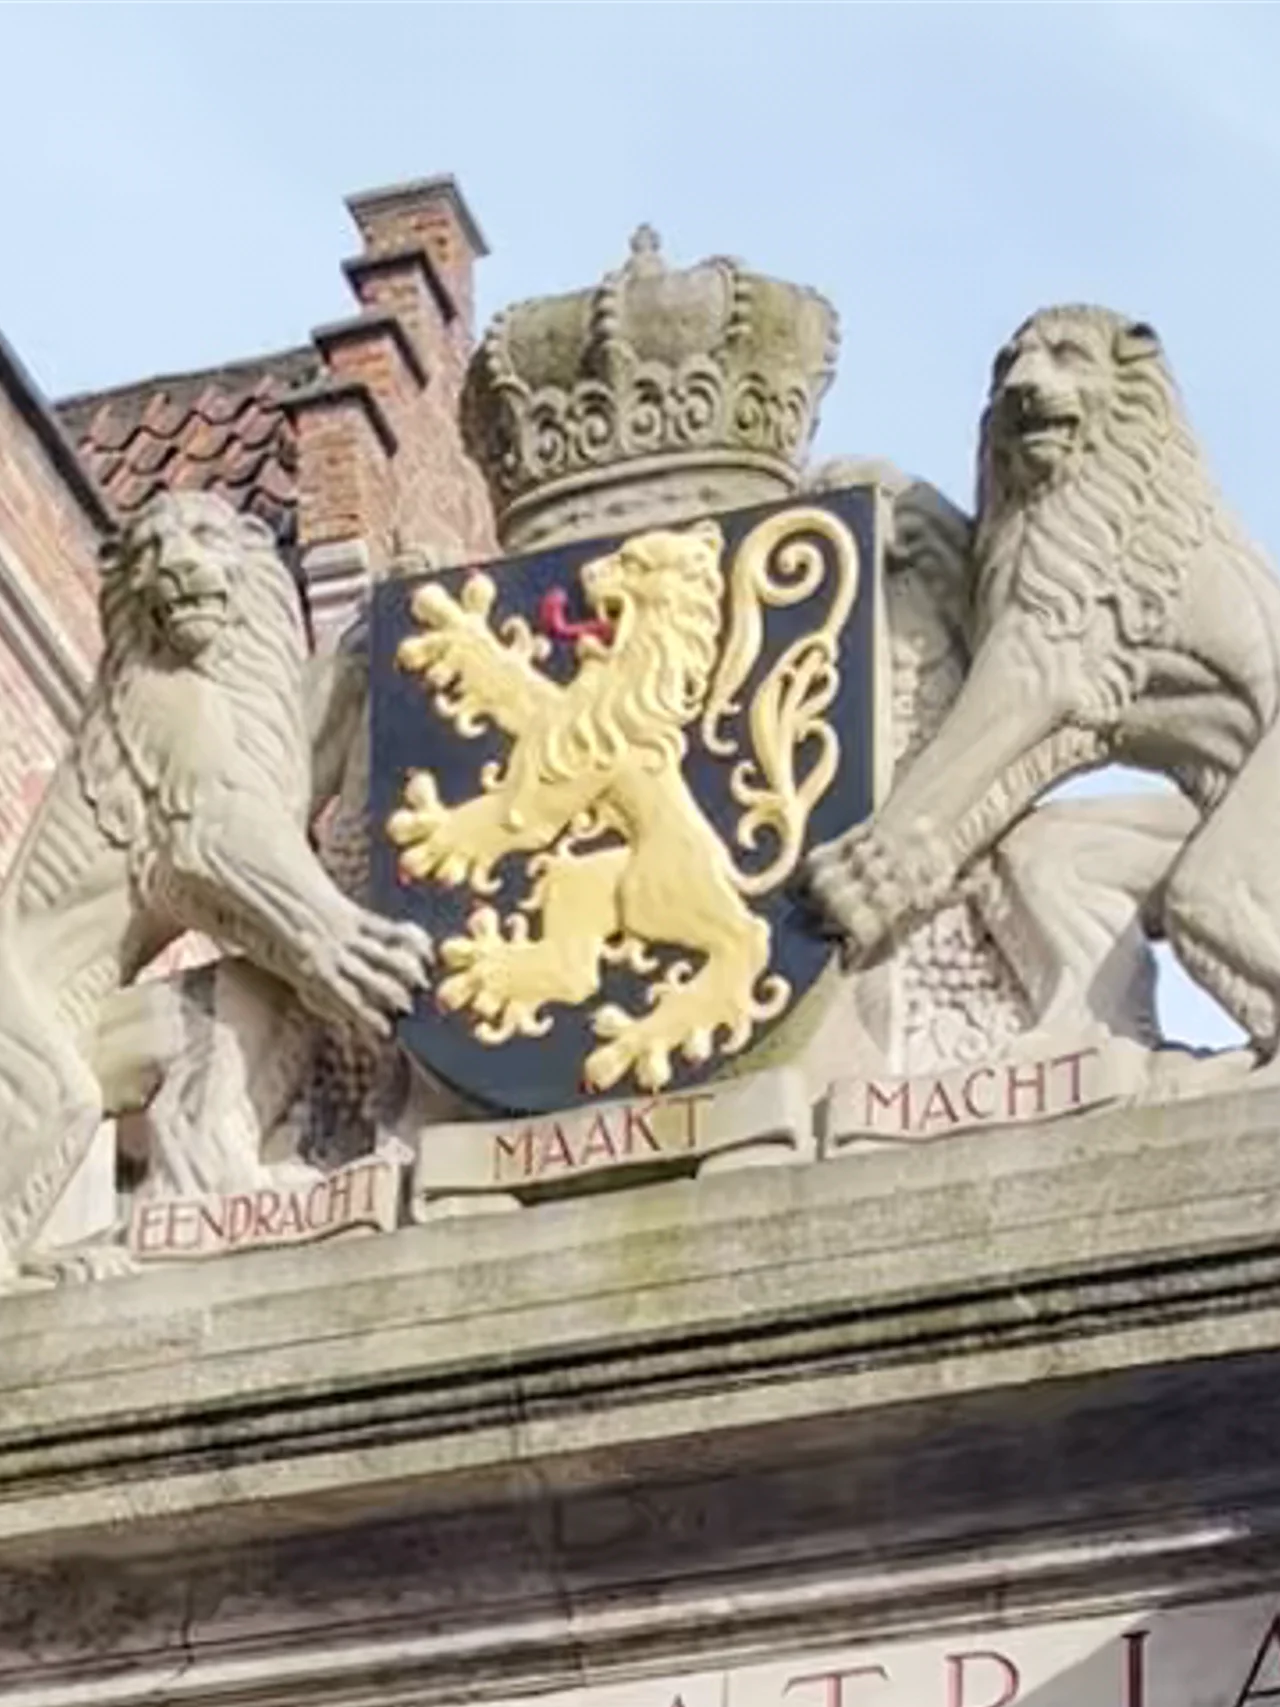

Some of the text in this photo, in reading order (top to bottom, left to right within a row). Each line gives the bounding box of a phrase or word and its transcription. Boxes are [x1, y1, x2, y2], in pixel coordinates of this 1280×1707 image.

[138, 1047, 1099, 1252] EENDRACHT MAAKT MACHT
